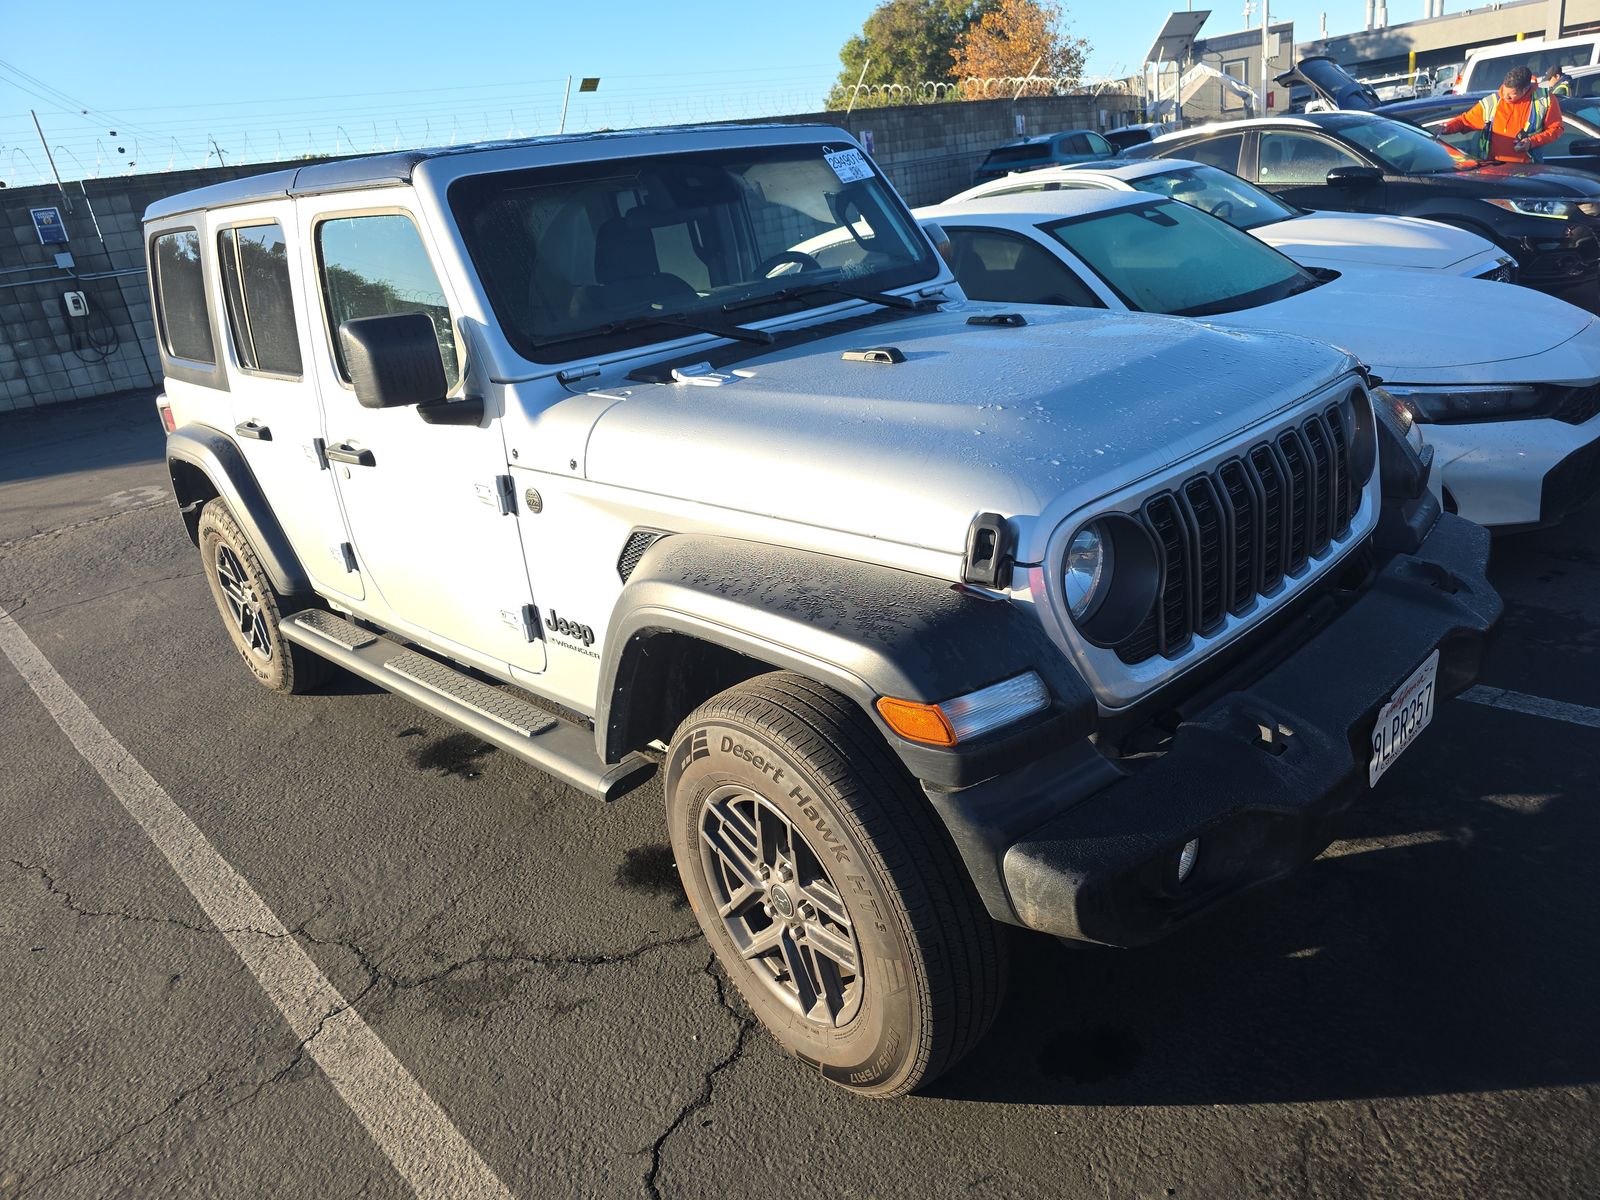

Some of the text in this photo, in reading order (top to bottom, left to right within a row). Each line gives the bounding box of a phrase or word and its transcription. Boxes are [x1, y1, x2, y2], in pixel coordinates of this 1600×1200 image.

[545, 608, 595, 647] Jeep
[1374, 681, 1433, 772] 9LPR357
[720, 736, 785, 784] Desert
[788, 784, 851, 864] Hawk
